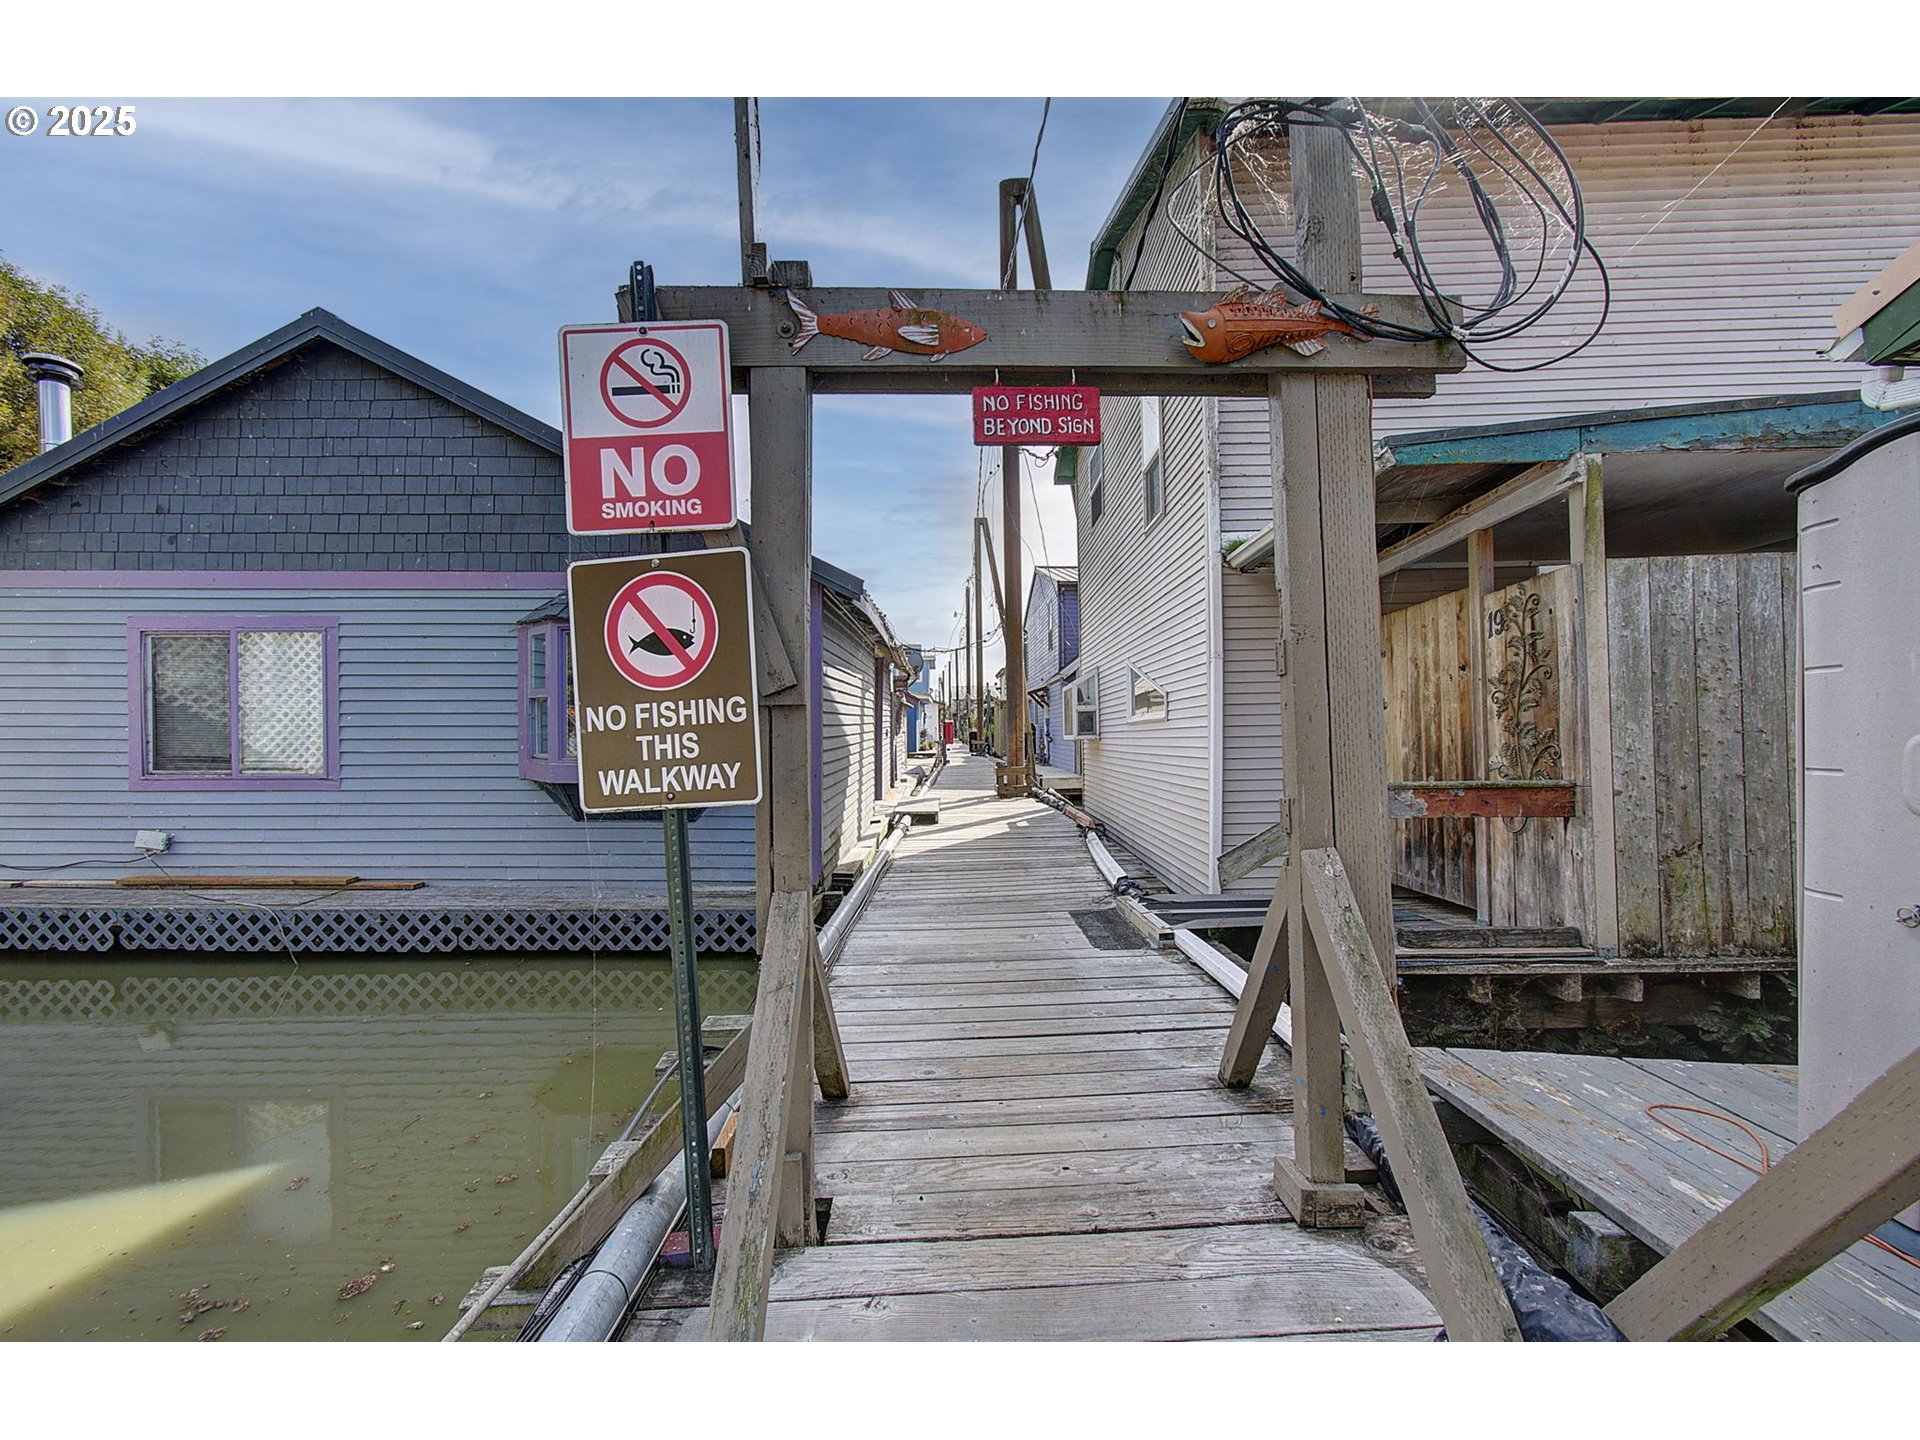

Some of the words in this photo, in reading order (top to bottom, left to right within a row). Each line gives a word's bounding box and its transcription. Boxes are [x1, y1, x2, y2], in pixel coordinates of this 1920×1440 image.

[983, 395, 1010, 412] NO
[1016, 393, 1083, 411] FISHING
[984, 417, 1052, 436] BEYOND
[600, 444, 701, 499] NO
[601, 498, 702, 519] SMOKING
[1487, 608, 1504, 639] 19
[586, 705, 626, 733] NO
[635, 695, 747, 729] FISHING
[635, 732, 700, 761] THIS
[598, 761, 741, 796] WALKWAY
